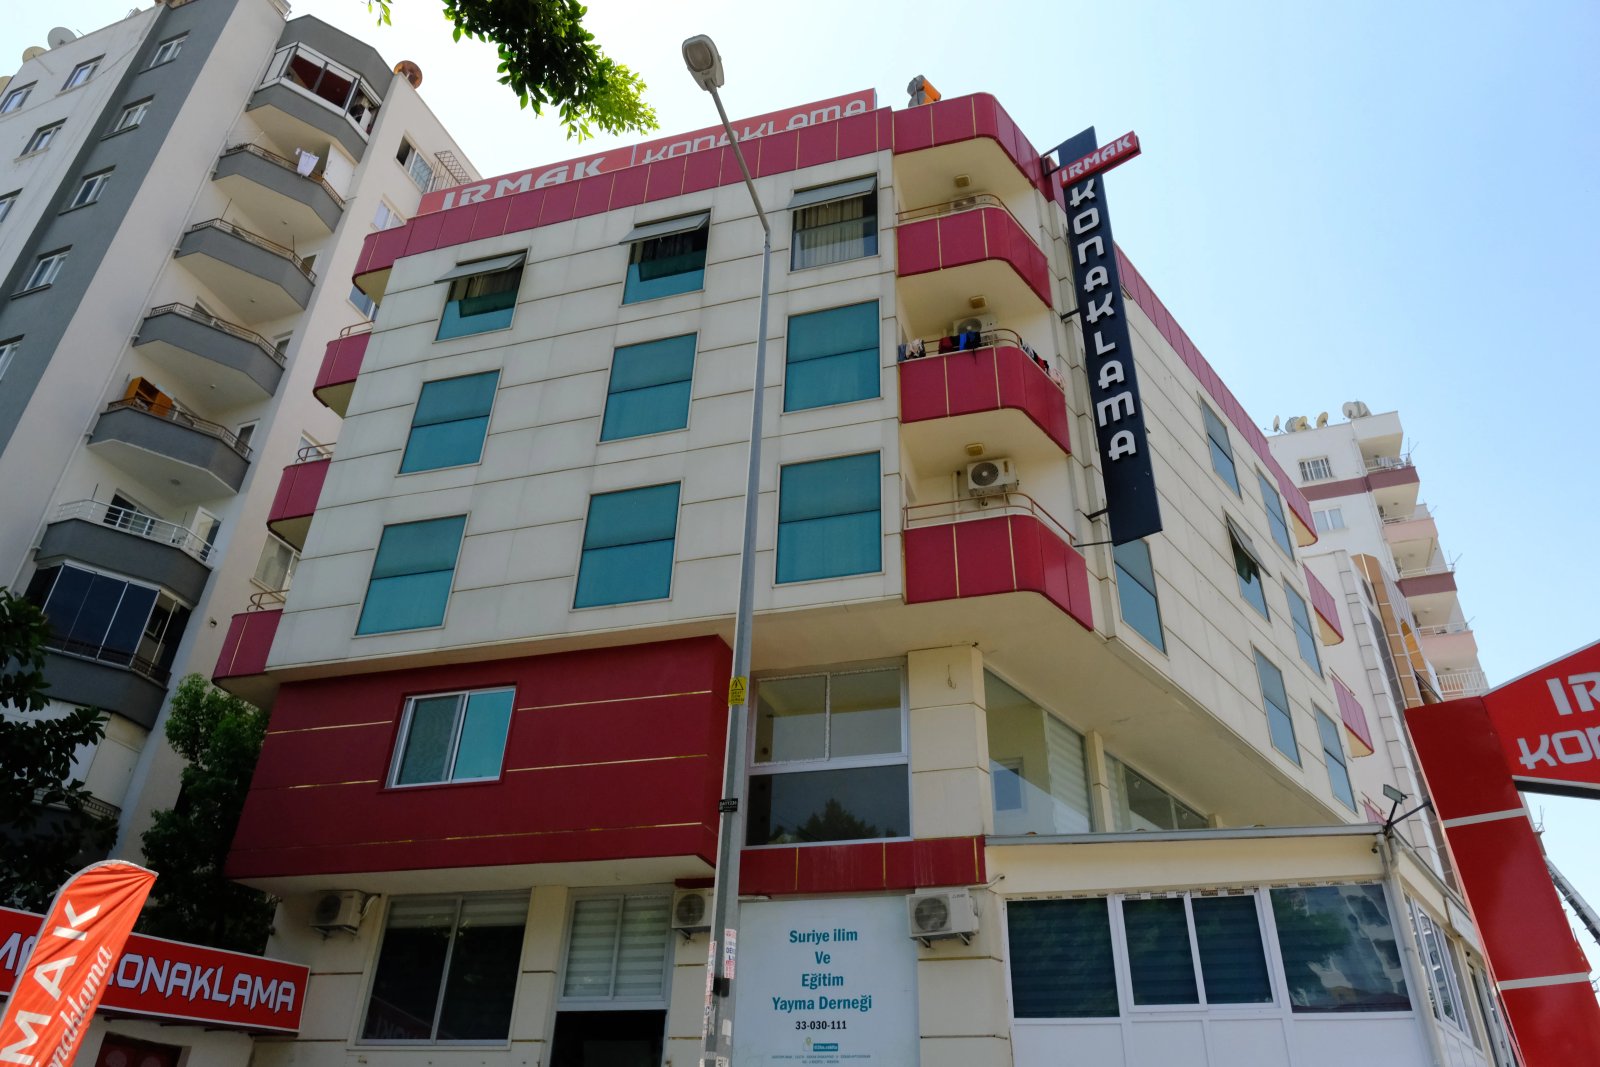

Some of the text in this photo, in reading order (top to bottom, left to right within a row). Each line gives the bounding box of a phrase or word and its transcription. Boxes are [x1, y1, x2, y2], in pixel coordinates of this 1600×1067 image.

[1061, 134, 1133, 183] IRMAK
[441, 156, 607, 211] IRMAK
[1069, 178, 1138, 462] KONAKLAMA
[789, 928, 858, 945] Suriye ilim
[815, 951, 831, 965] Ve
[107, 954, 297, 1014] ONAKLAMA
[801, 973, 844, 990] Eğitim
[772, 994, 873, 1014] Yayma Derneği
[795, 1020, 848, 1030] 33-030-111
